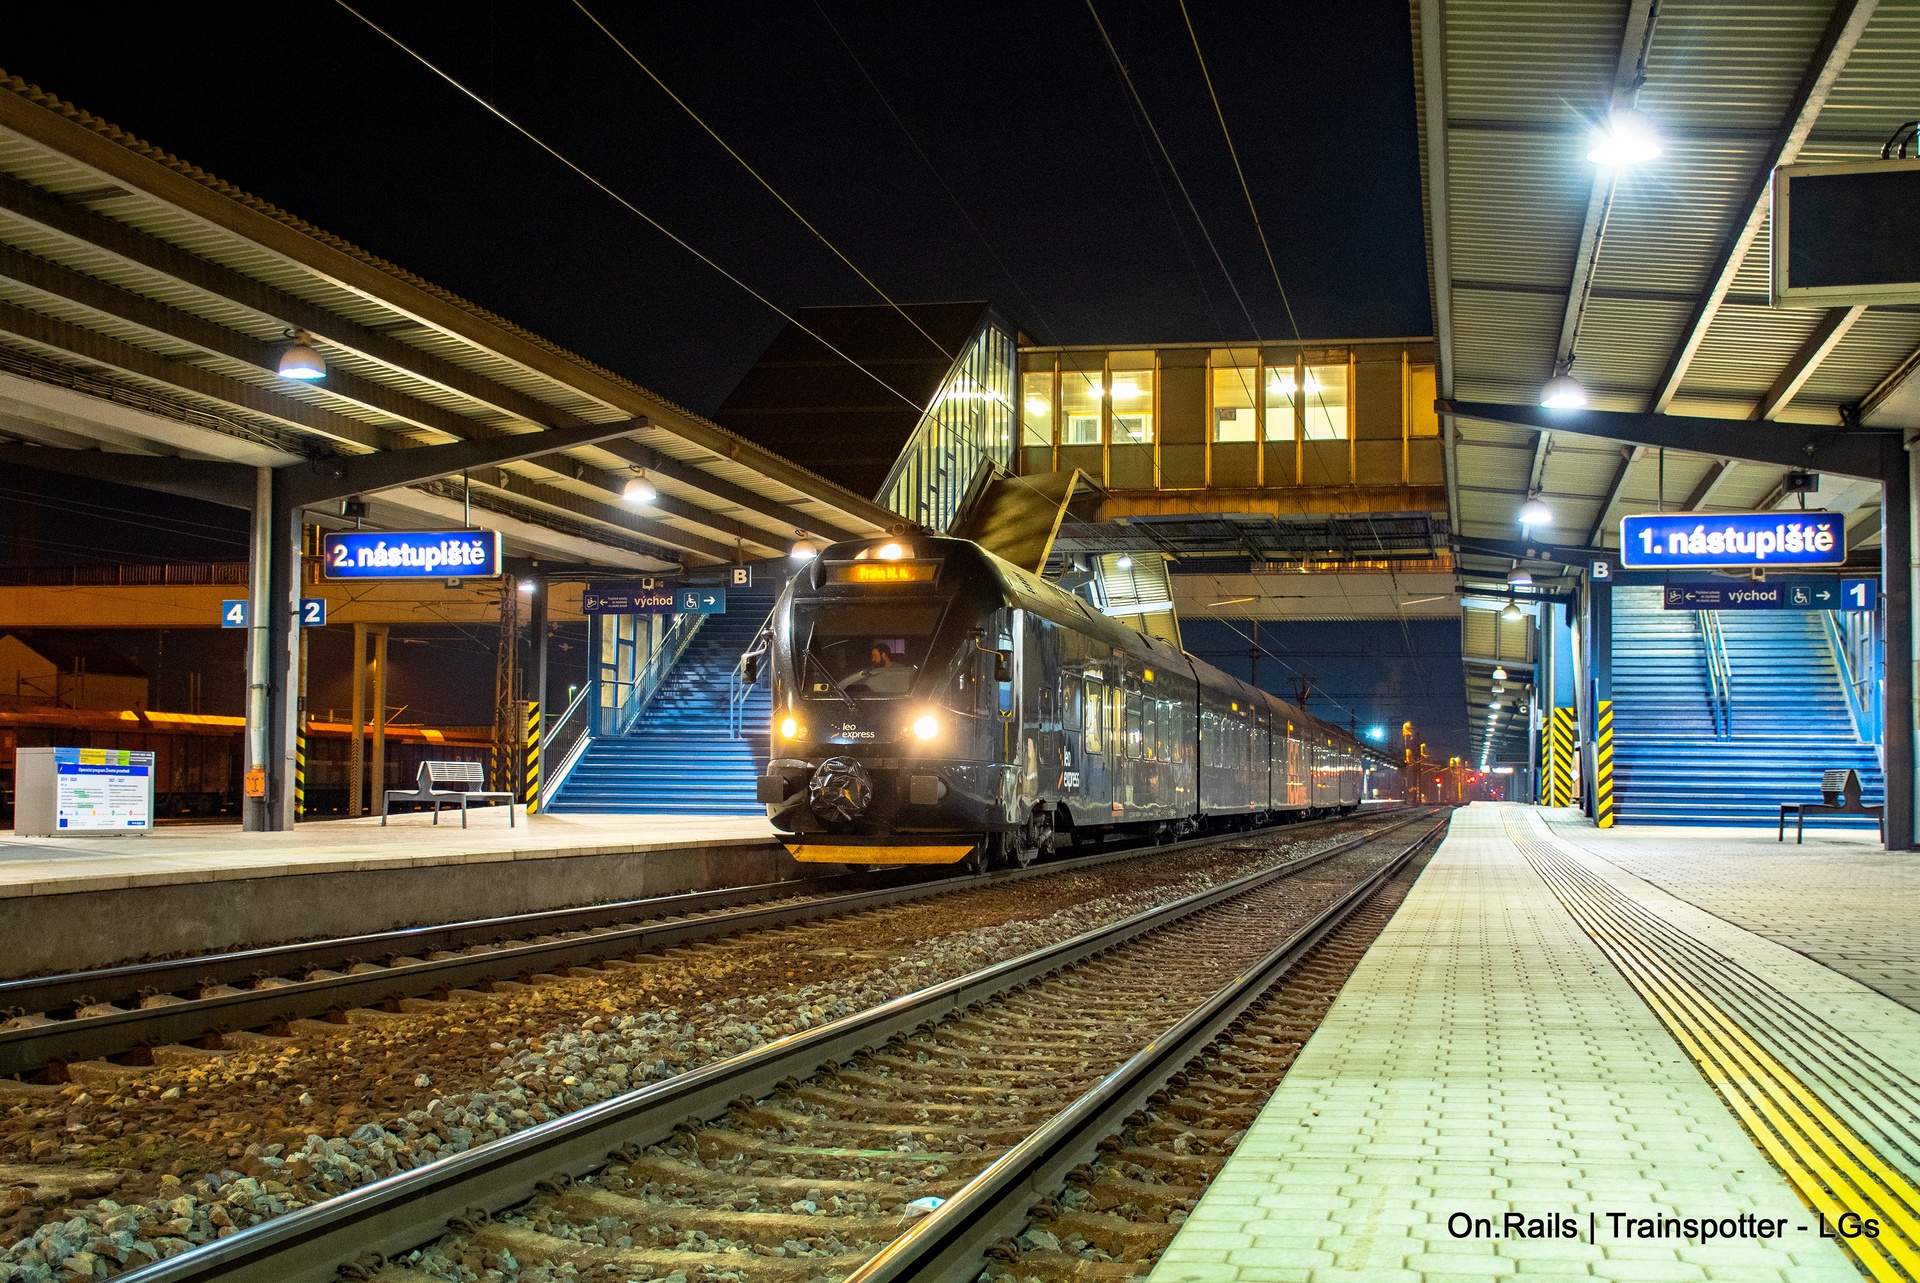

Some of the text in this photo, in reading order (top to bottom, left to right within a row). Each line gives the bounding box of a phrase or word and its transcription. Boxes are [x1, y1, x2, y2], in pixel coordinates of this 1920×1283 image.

[1638, 523, 1835, 559] 1. nástupiště
[333, 540, 486, 572] 2. nástupiště
[733, 569, 748, 584] B
[1593, 562, 1608, 578] B
[634, 595, 673, 608] východ
[1728, 589, 1777, 603] východ
[1850, 583, 1866, 607] 1
[227, 603, 243, 624] 4
[304, 602, 320, 623] 2
[842, 722, 857, 731] leo
[842, 731, 875, 740] express
